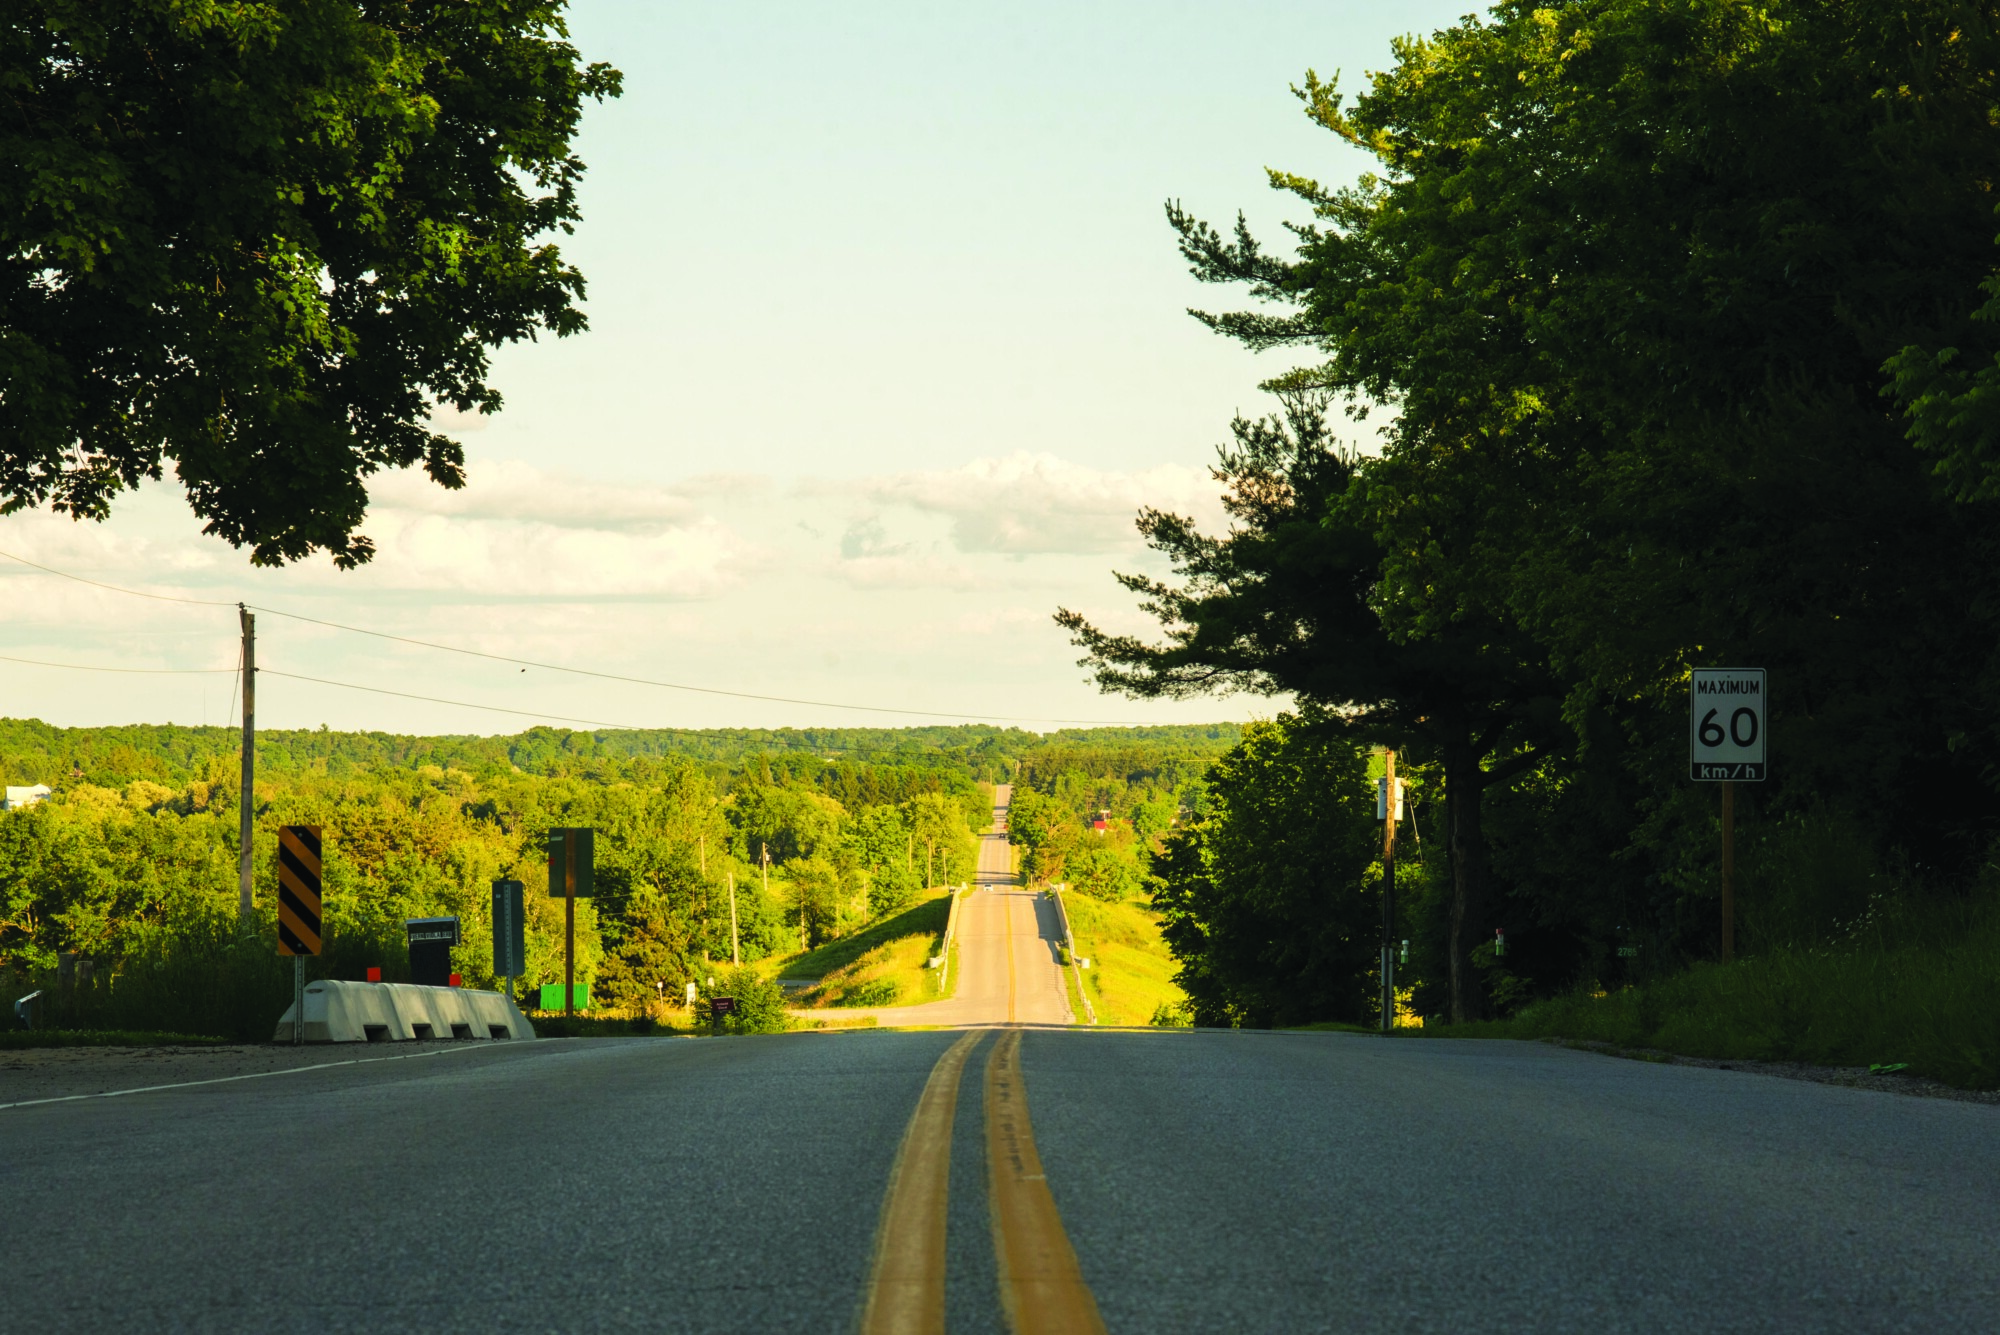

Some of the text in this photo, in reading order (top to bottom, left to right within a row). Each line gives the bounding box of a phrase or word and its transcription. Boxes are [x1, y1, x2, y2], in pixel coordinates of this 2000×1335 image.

[1698, 680, 1759, 694] MAXIMUM
[1698, 707, 1758, 747] 60
[1701, 764, 1755, 778] km/h
